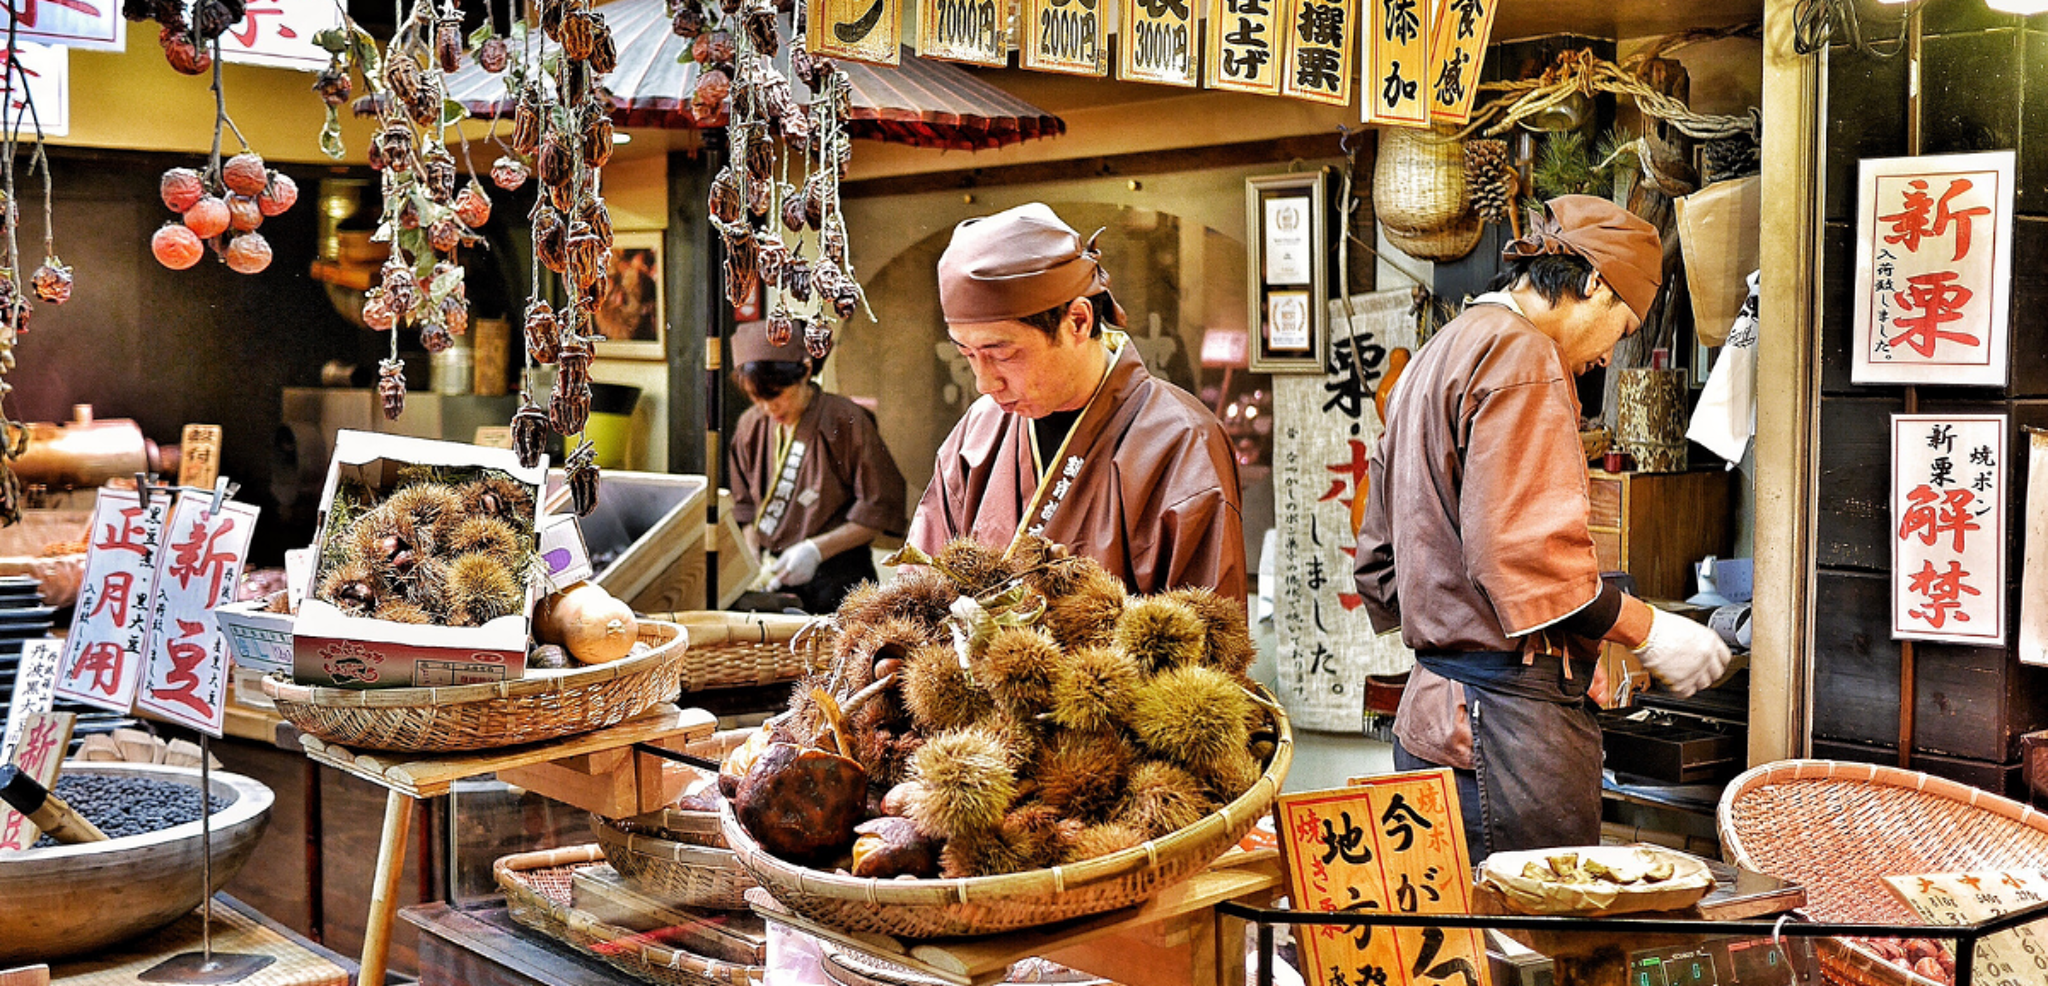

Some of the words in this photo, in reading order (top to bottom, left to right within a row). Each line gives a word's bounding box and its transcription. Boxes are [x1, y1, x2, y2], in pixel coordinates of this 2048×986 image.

[1041, 8, 1096, 63] 2000円
[1135, 20, 1187, 73] 3000円
[1875, 249, 1897, 360] 入荷致しました。
[1879, 178, 1991, 358] 新栗
[1926, 424, 1958, 487] 新栗
[1970, 445, 1996, 517] 焼ポン
[71, 507, 148, 695] 正月用
[1305, 513, 1343, 694] しました。
[1899, 484, 1981, 628] 解禁
[152, 510, 238, 719] 新豆
[1416, 782, 1453, 891] 焼ポン
